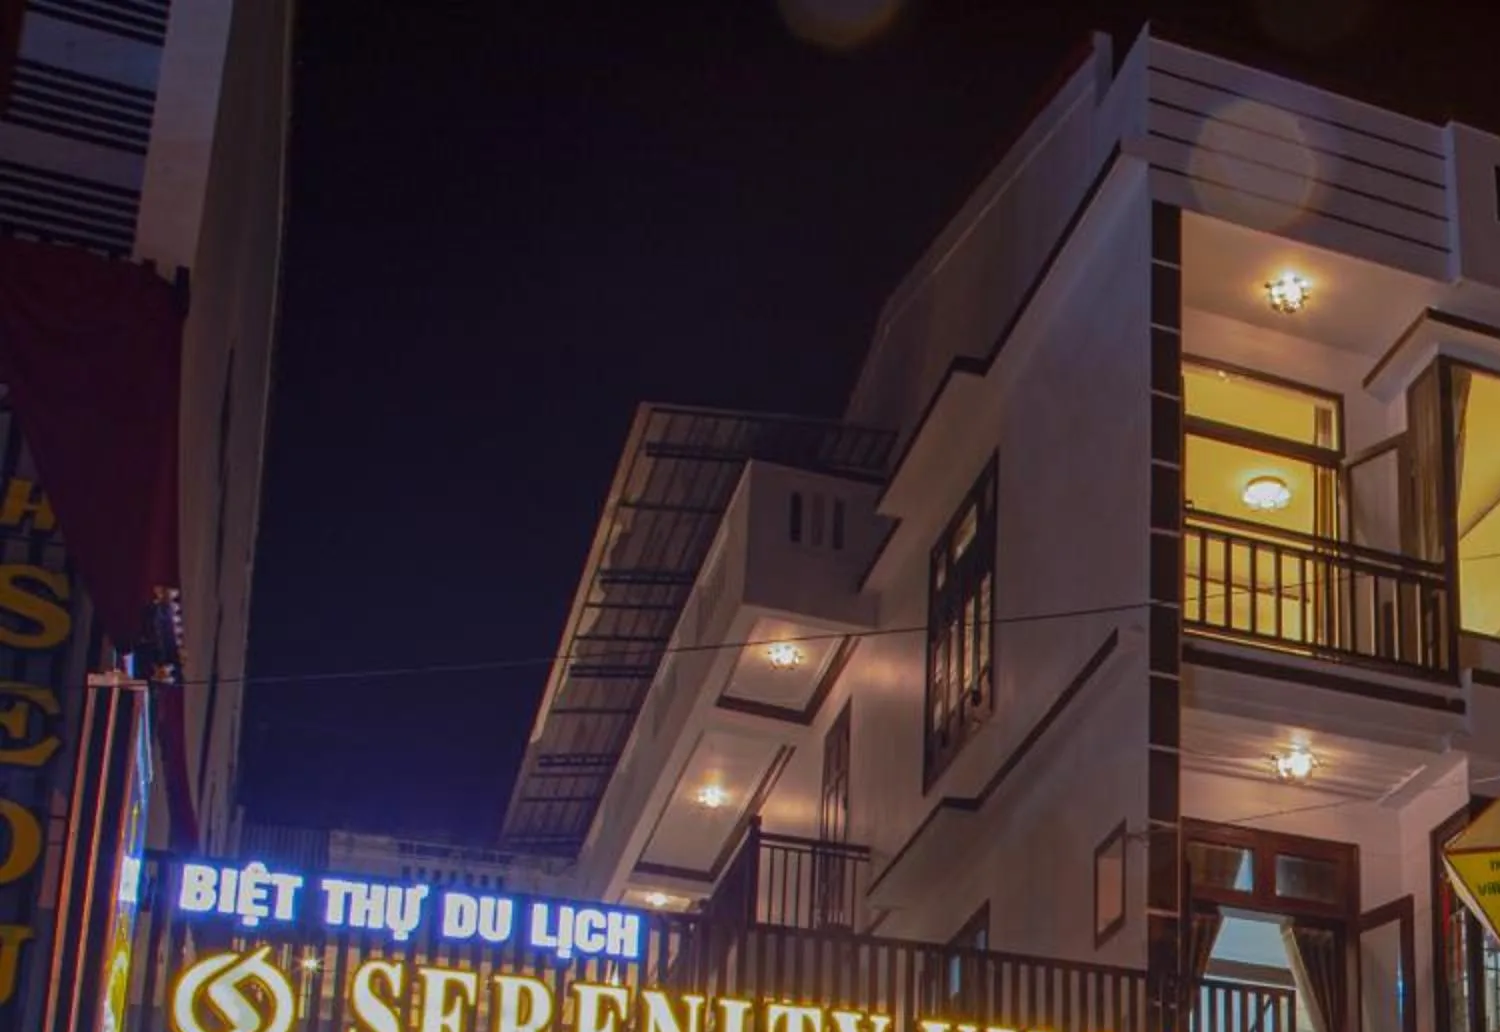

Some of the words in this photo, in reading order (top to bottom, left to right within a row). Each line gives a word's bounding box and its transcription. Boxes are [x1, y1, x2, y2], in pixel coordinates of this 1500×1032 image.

[179, 861, 302, 926] BIỆT
[321, 878, 429, 940] THỰ
[443, 891, 513, 942] DU
[531, 901, 640, 958] LỊCH
